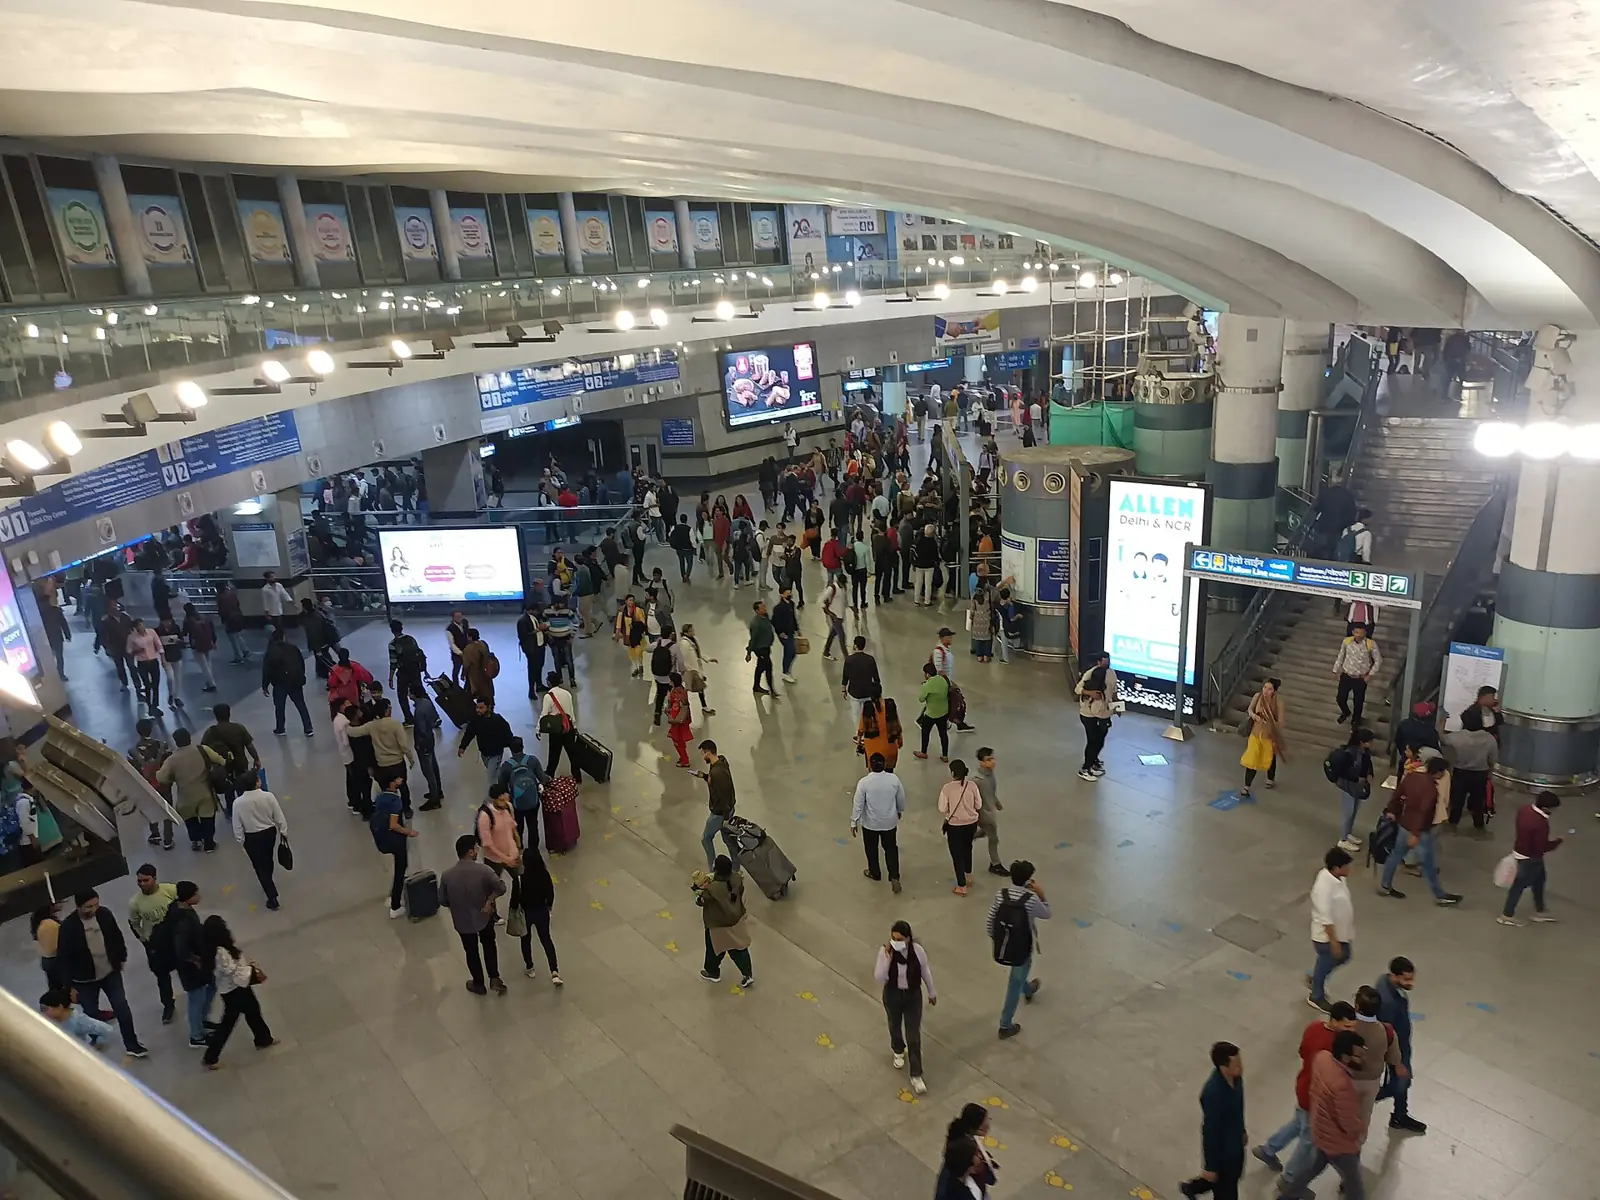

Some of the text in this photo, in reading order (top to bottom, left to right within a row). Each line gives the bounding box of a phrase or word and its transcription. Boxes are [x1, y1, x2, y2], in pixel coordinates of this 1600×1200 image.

[1119, 493, 1194, 519] ALLEN
[1119, 514, 1191, 531] Delhi & NCR
[1228, 553, 1243, 564] येलो
[1228, 565, 1252, 574] Yellow
[1252, 567, 1268, 576] Line
[1353, 572, 1364, 587] 3
[3, 629, 20, 645] SONY
